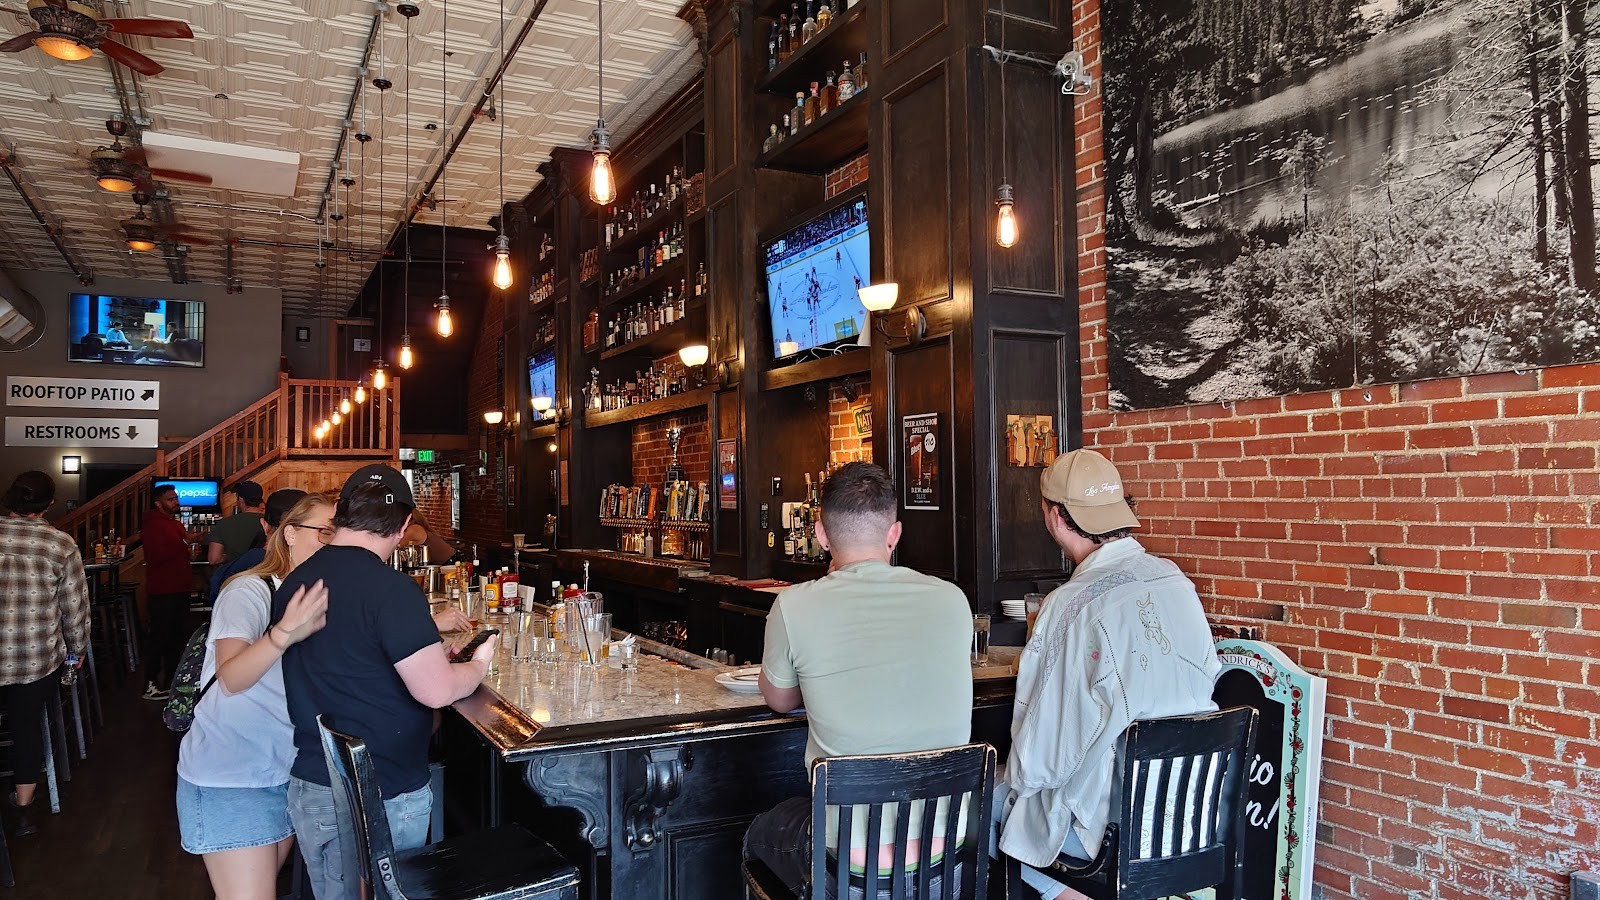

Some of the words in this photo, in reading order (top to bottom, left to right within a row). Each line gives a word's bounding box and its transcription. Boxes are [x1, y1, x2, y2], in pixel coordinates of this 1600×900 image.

[11, 385, 87, 400] ROOFTOP
[91, 387, 135, 401] PATIO
[916, 419, 925, 427] AND
[25, 425, 120, 439] RESTROOMS
[418, 450, 433, 462] EXIT
[180, 488, 210, 499] pepsi
[1085, 486, 1098, 496] Los
